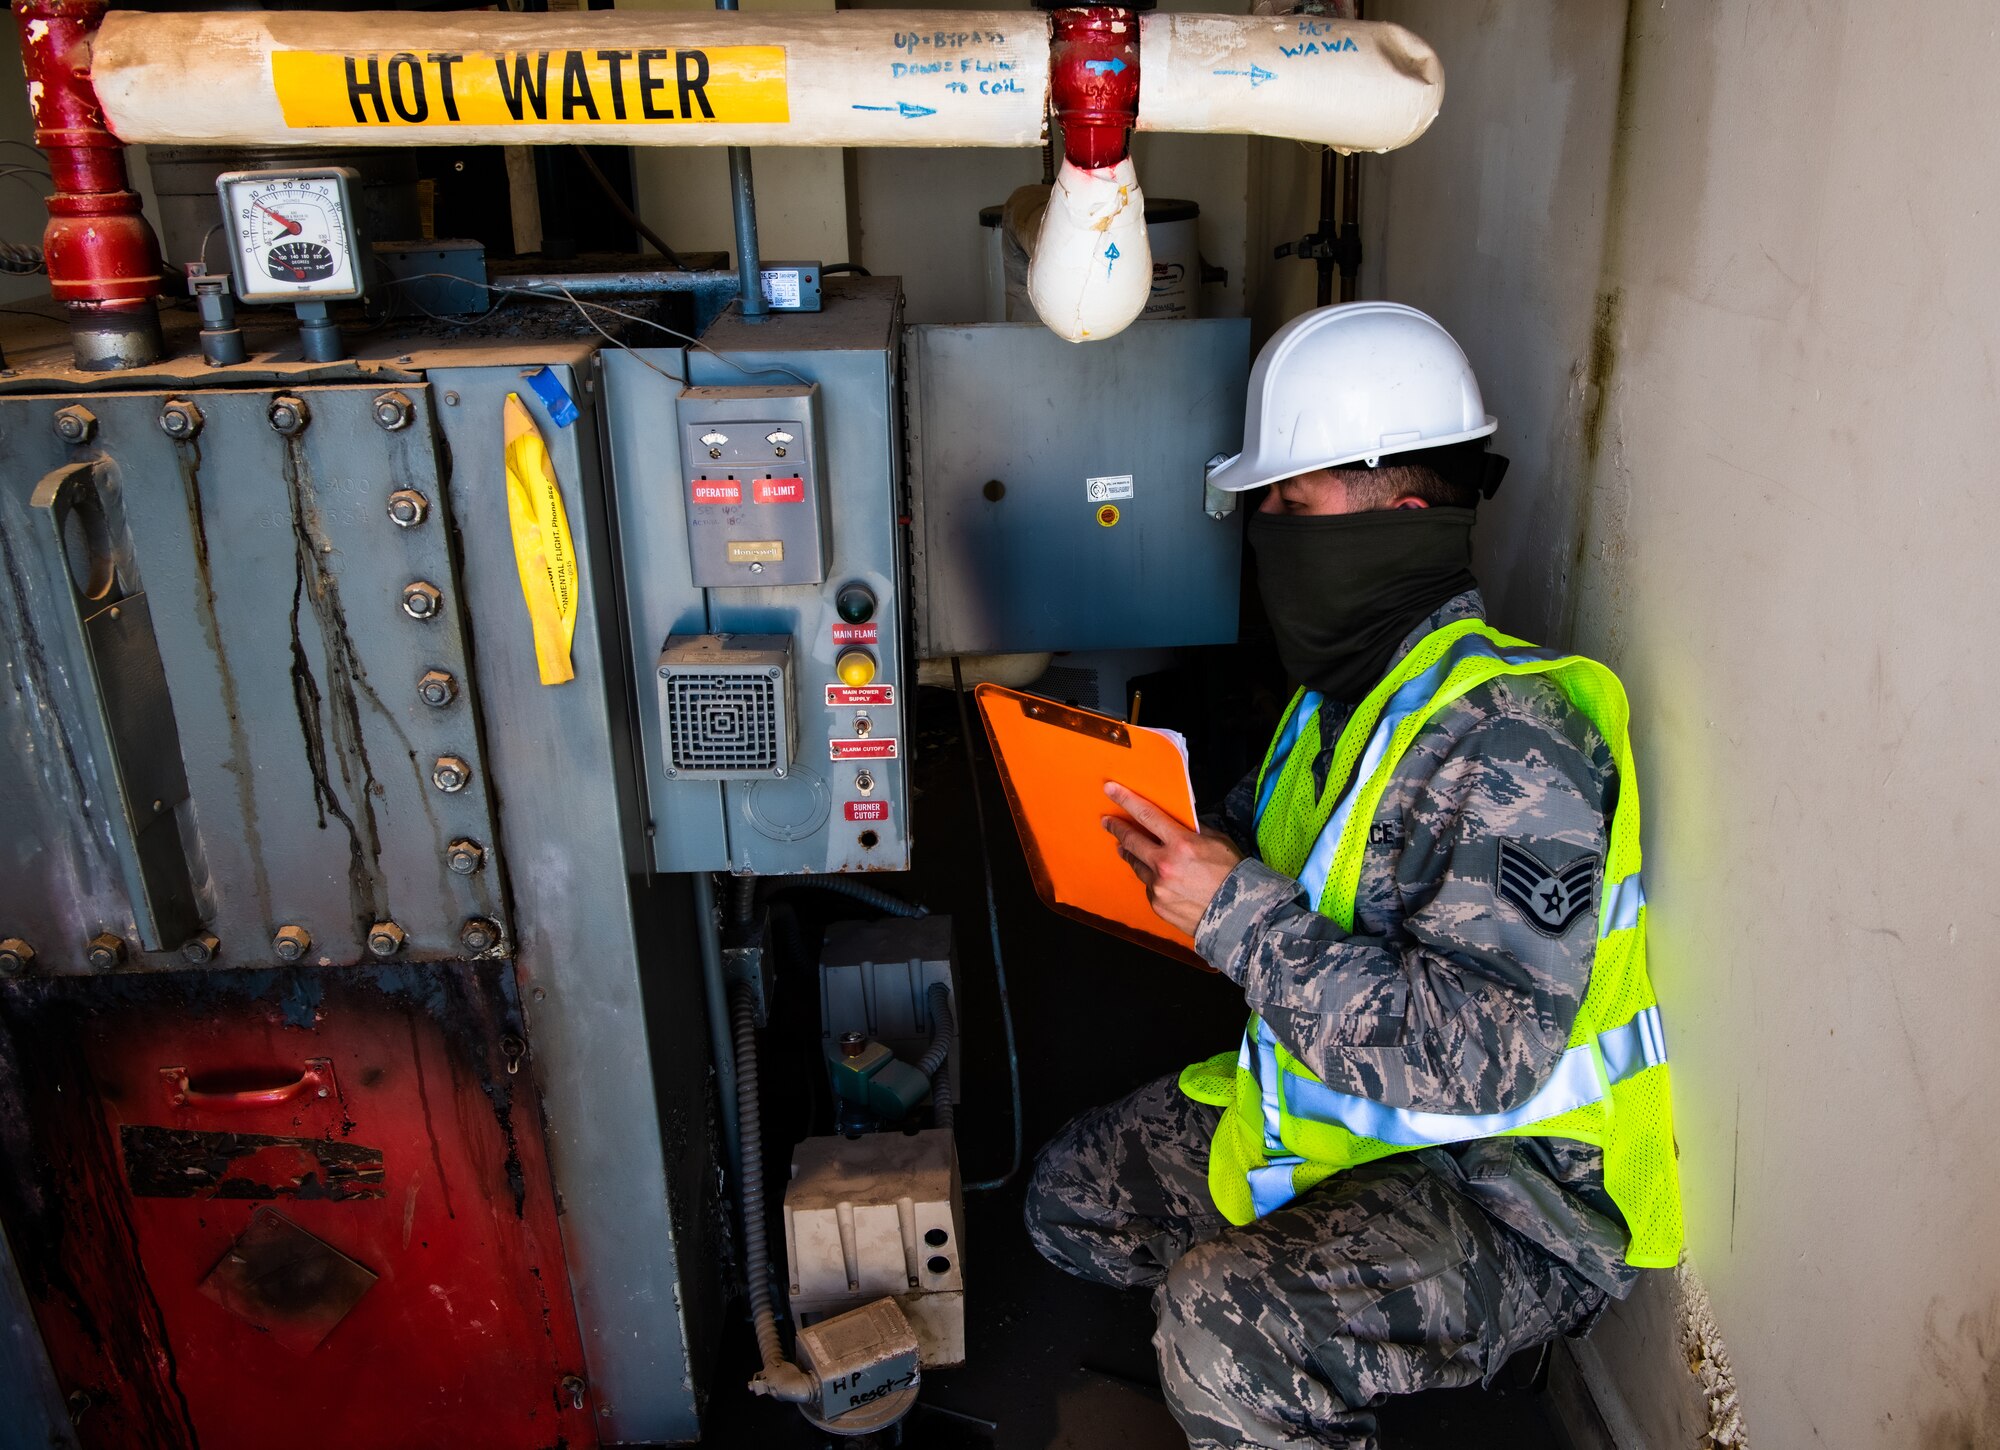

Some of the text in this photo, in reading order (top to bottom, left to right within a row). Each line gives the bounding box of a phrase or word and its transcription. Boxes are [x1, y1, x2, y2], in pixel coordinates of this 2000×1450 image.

[1279, 37, 1359, 58] WAWA
[344, 49, 716, 123] HOT WATER
[945, 81, 969, 94] TO
[266, 184, 276, 192] 40
[300, 182, 310, 190] 60
[319, 186, 329, 195] 70
[249, 191, 259, 200] 30
[243, 209, 250, 219] 20
[242, 230, 250, 239] 10
[695, 487, 739, 498] OPERATING
[762, 485, 796, 497] HI-LIMIT
[733, 548, 777, 556] Honeywell
[833, 629, 877, 639] MAIN FLAME
[853, 803, 880, 811] BURNER
[854, 811, 880, 820] CUTOFF
[1367, 823, 1395, 845] CE
[833, 1372, 862, 1395] HP
[850, 1378, 896, 1407] Reset
